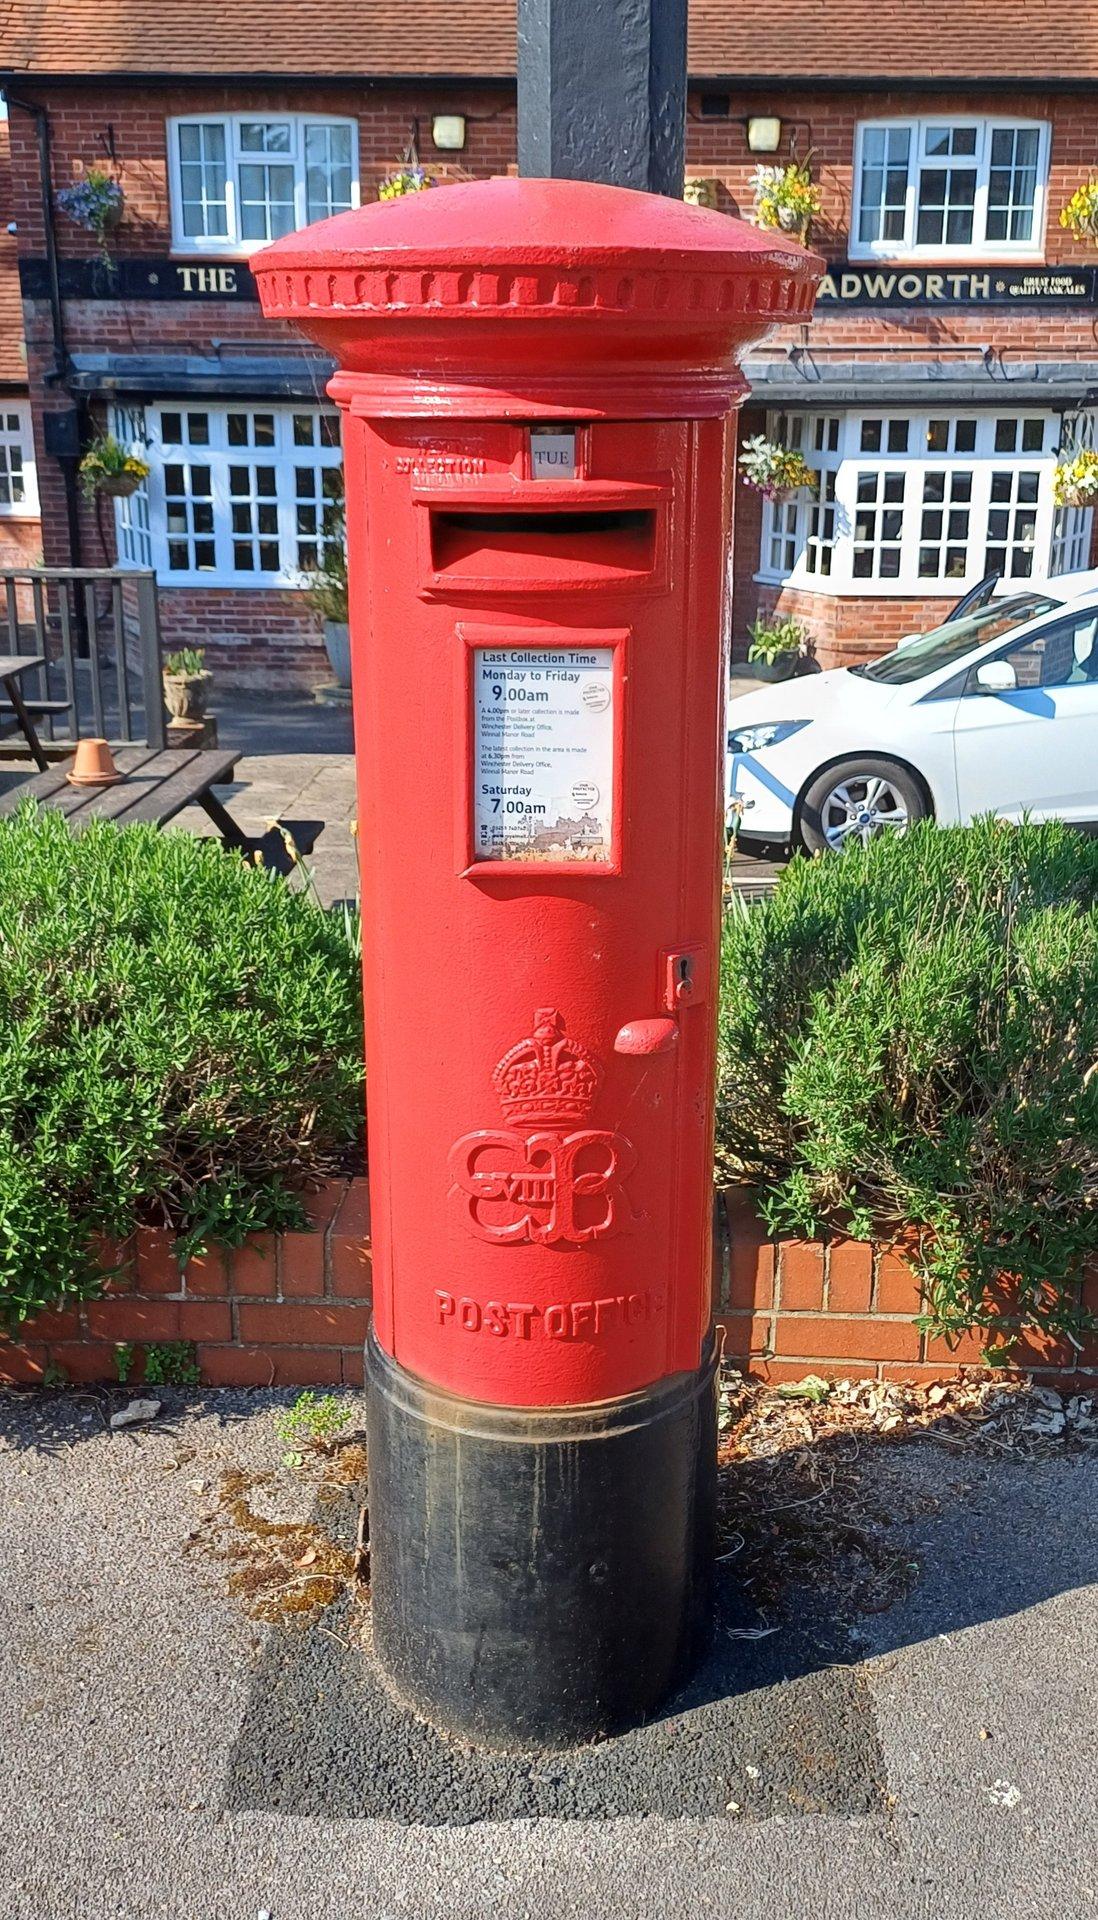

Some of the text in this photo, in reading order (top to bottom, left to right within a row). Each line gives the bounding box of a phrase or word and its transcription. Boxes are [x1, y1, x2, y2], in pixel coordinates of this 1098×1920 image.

[176, 267, 990, 299] THE ADWORTH
[534, 451, 569, 465] TUE
[482, 651, 597, 664] Last Collection Time
[482, 670, 580, 684] Monday to Friday
[492, 685, 549, 702] 9.00am
[513, 723, 535, 731] Delivery
[481, 760, 511, 768] Winchester
[512, 761, 534, 769] Delivery
[481, 784, 532, 797] Saturday
[490, 798, 546, 814] 7.00am
[434, 1289, 664, 1339] POST OFFIC
